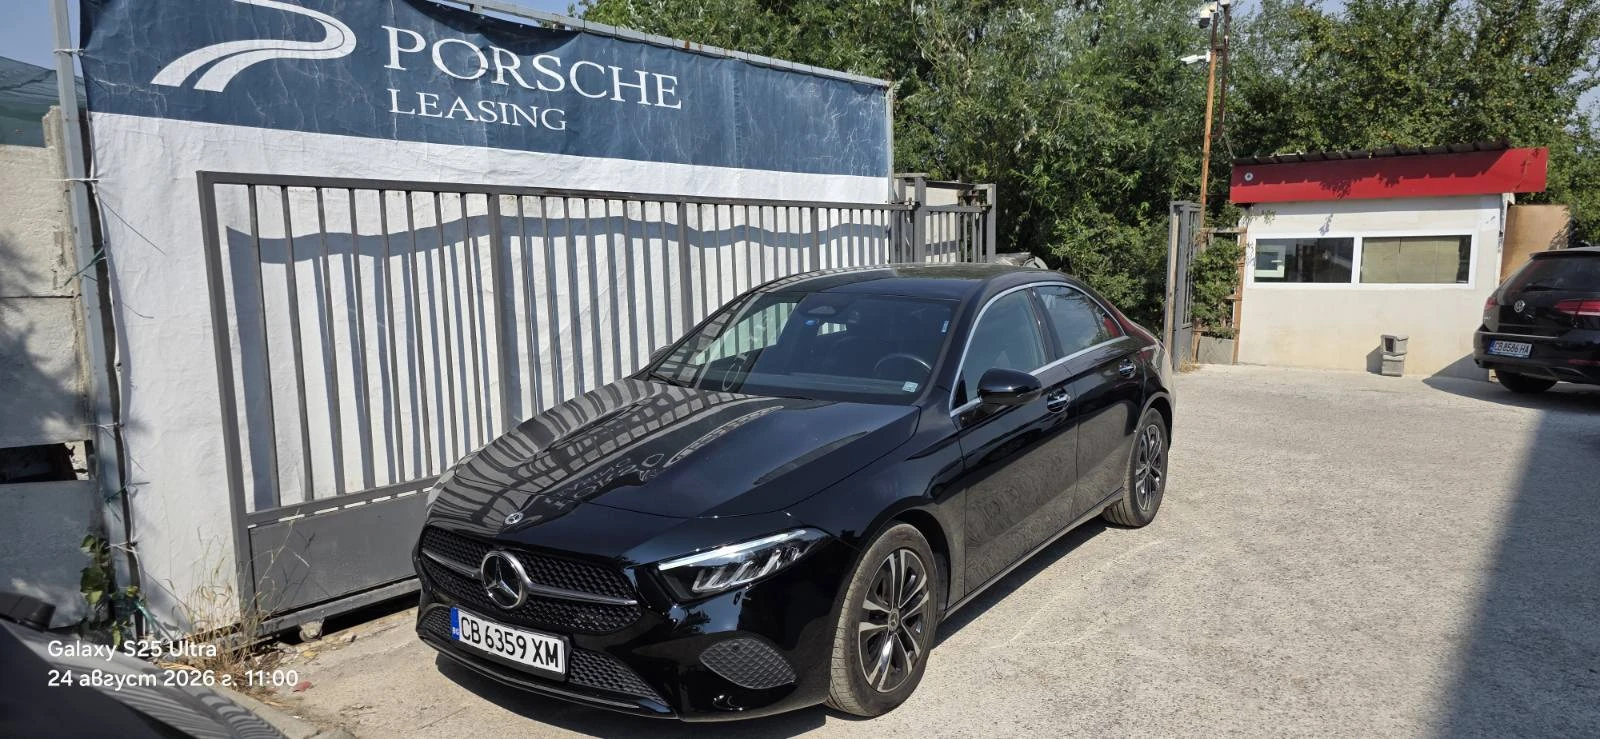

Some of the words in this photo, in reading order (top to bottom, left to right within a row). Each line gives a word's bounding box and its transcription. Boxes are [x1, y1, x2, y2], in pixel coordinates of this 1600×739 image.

[381, 25, 682, 109] PORSCHE
[387, 88, 567, 131] LEASING
[461, 617, 481, 644] CB
[485, 626, 527, 659] 6359
[531, 638, 558, 668] XM
